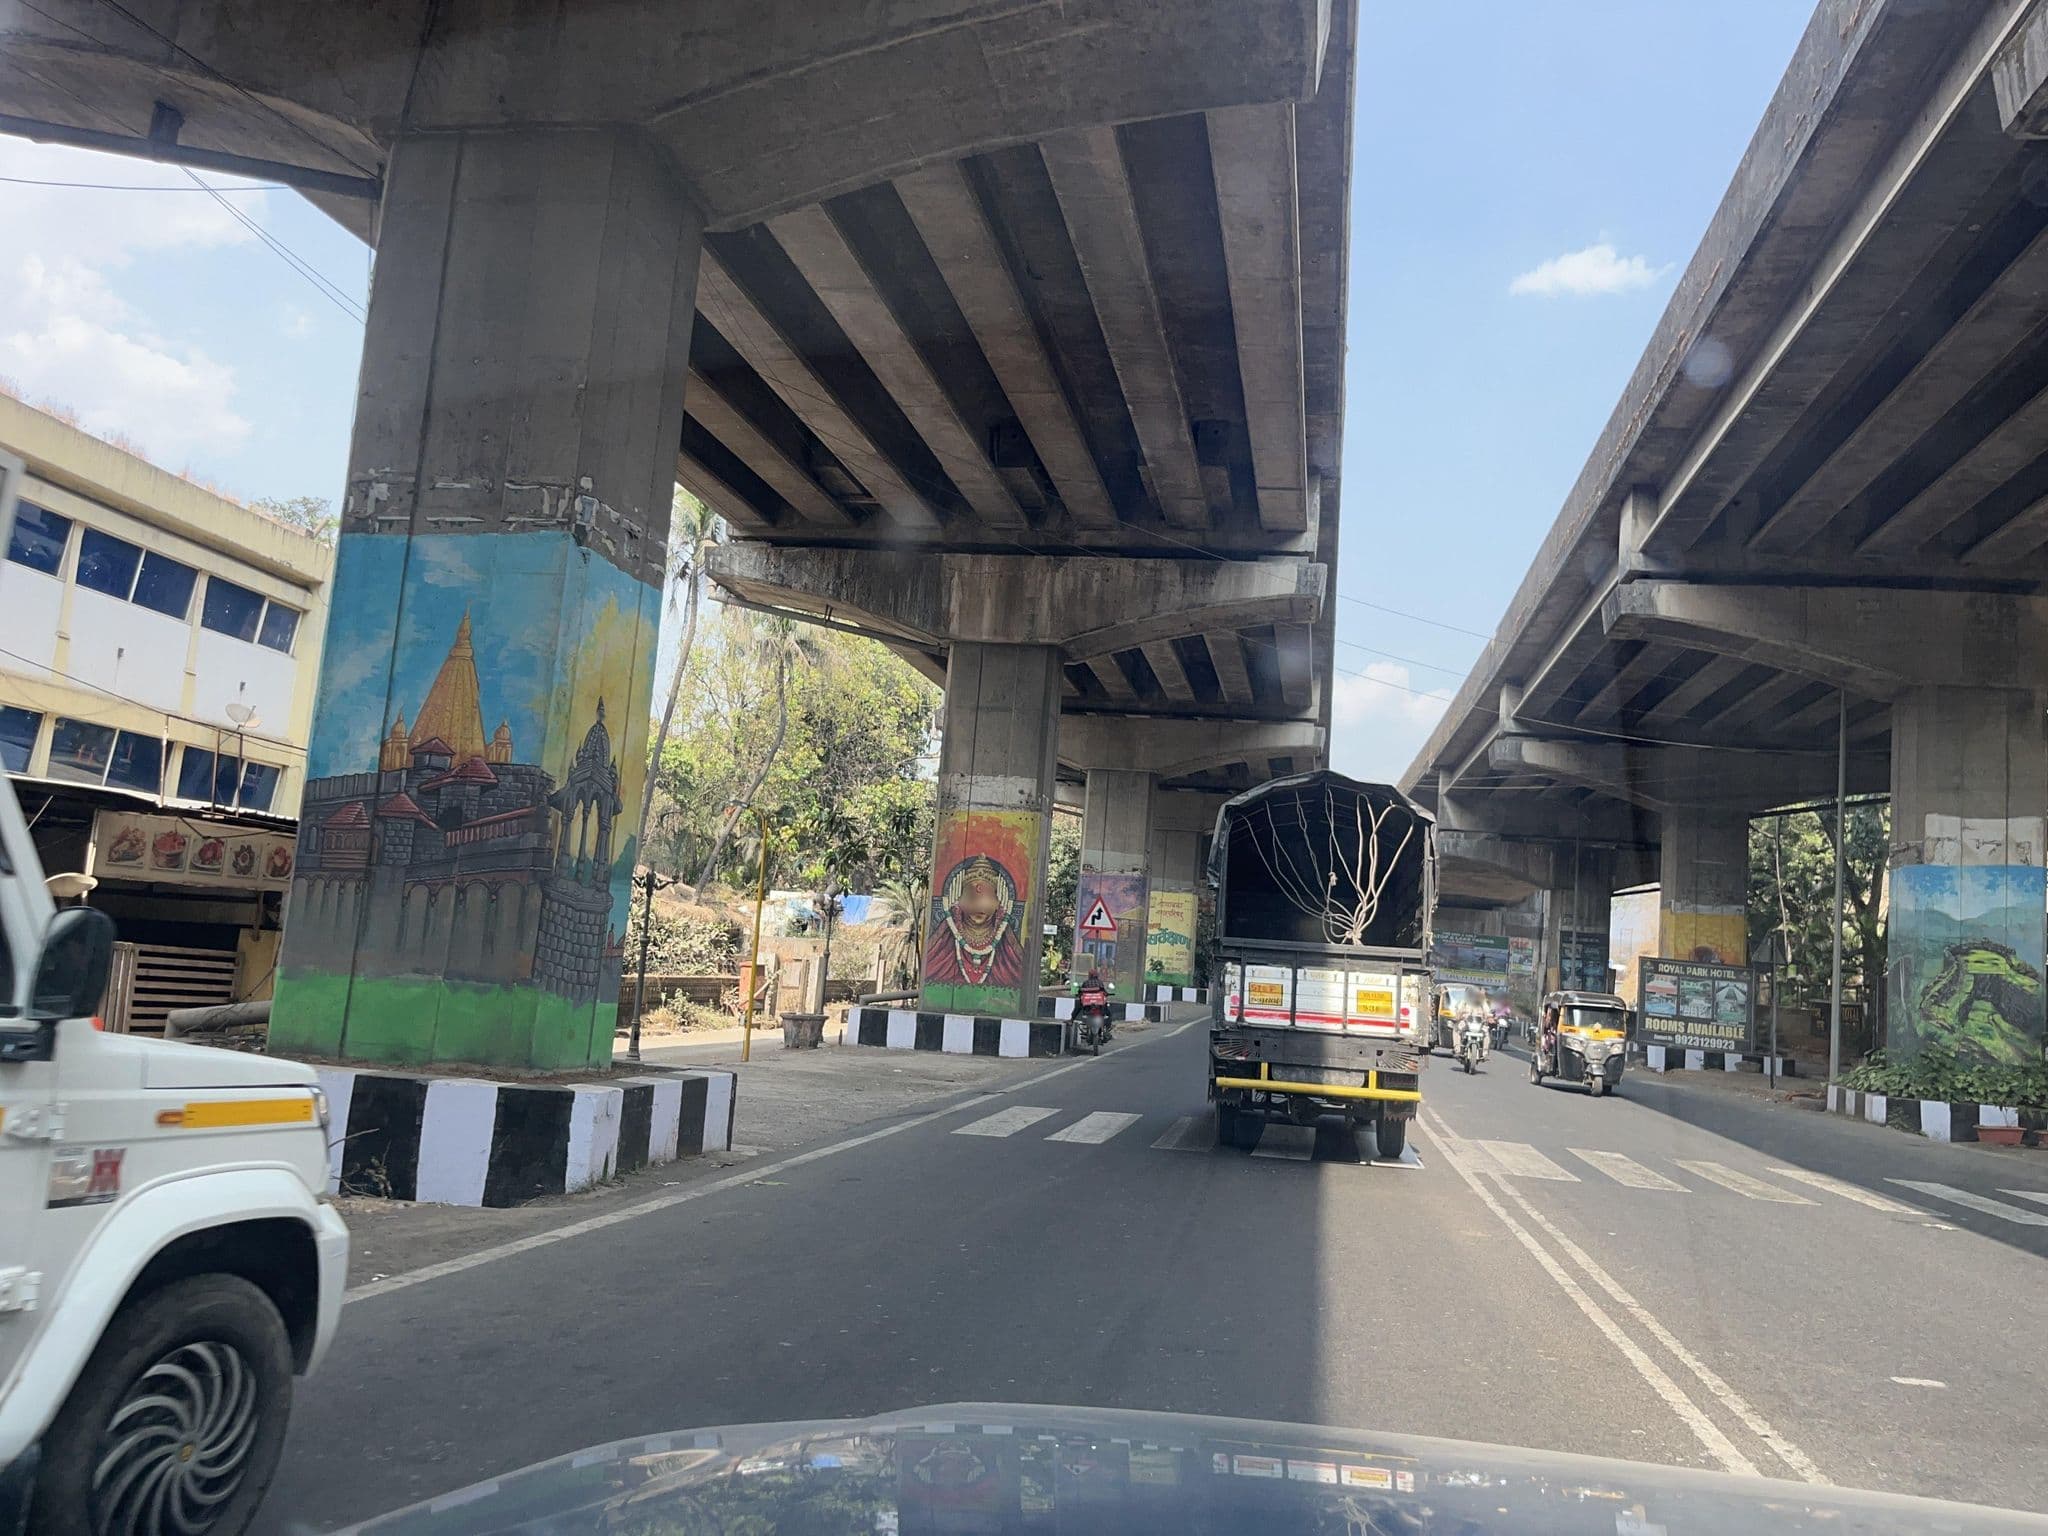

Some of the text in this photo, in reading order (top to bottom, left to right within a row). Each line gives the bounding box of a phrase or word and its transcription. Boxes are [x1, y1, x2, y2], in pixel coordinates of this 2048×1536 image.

[1658, 963, 1736, 979] ROYAL PARK HOTEL
[1645, 1017, 1685, 1033] ROOMS
[1687, 1022, 1745, 1039] AVAILABLE
